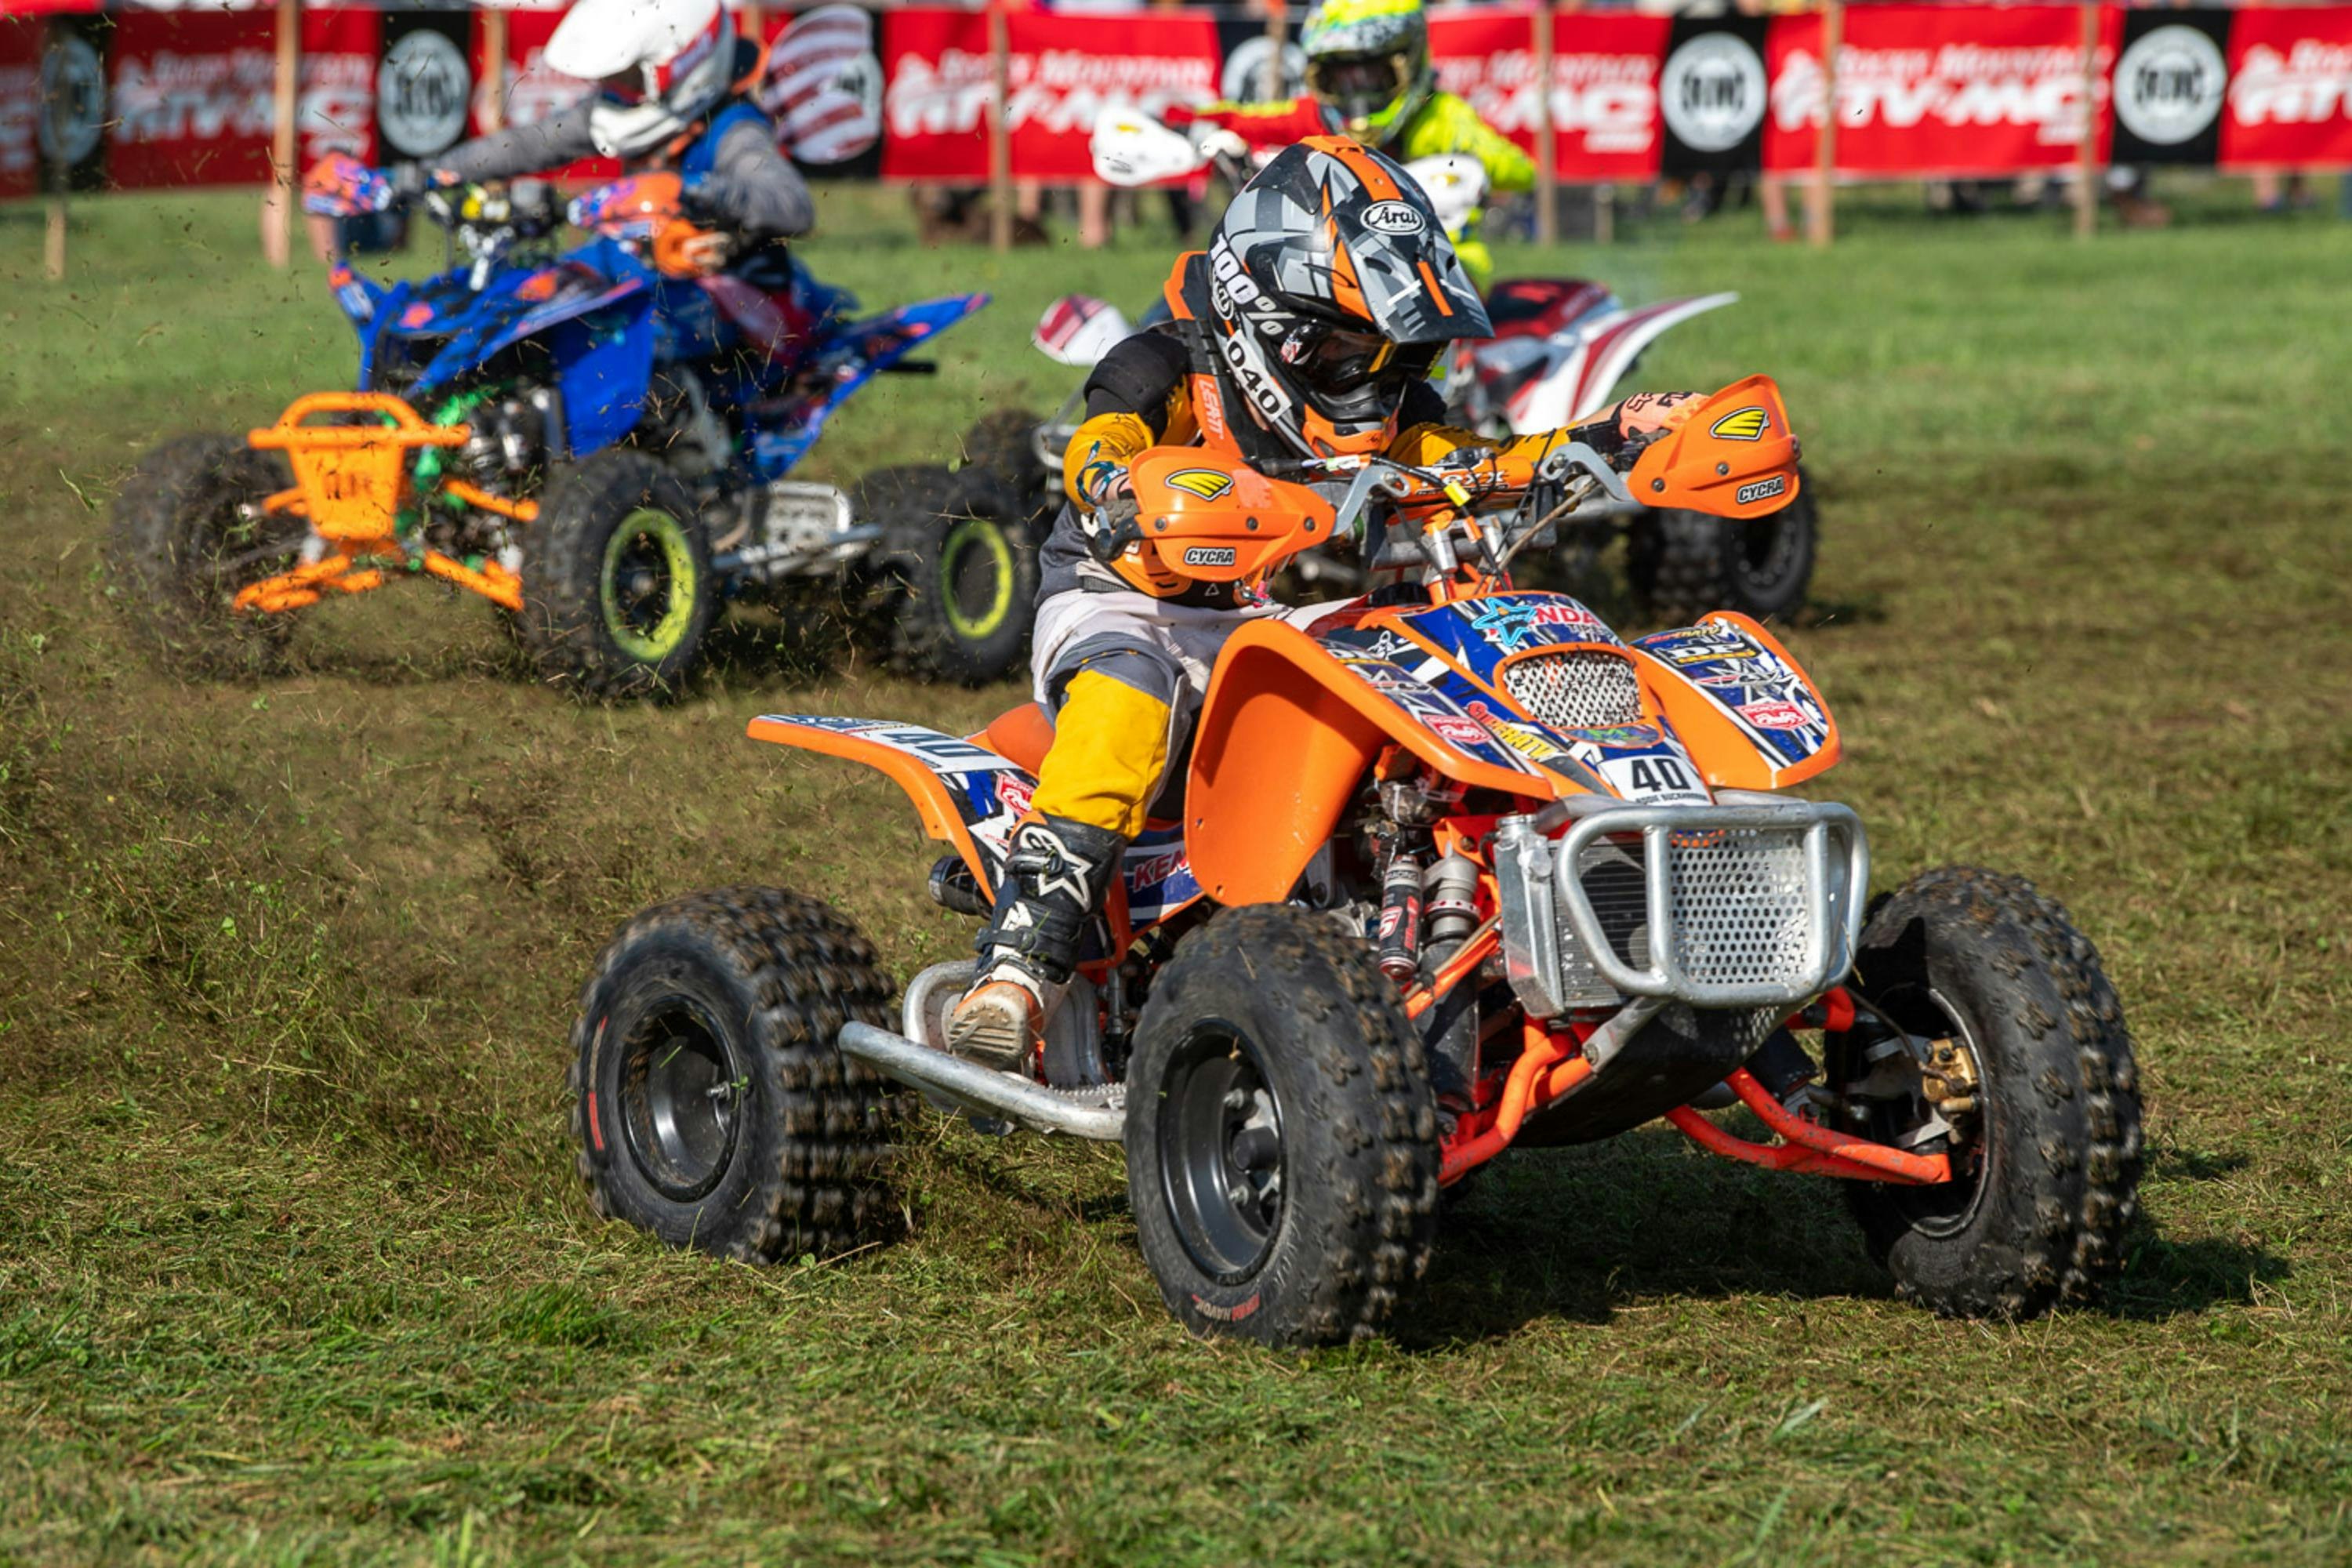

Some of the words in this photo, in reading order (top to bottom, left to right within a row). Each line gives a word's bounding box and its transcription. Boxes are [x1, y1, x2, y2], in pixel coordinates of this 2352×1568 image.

[1364, 205, 1417, 226] Arai
[1210, 233, 1298, 336] 100%
[1227, 339, 1282, 415] 040
[1198, 379, 1225, 440] LEATT
[1738, 478, 1784, 502] CYCRA
[1186, 550, 1235, 563] CYCRA
[1632, 758, 1691, 792] 40
